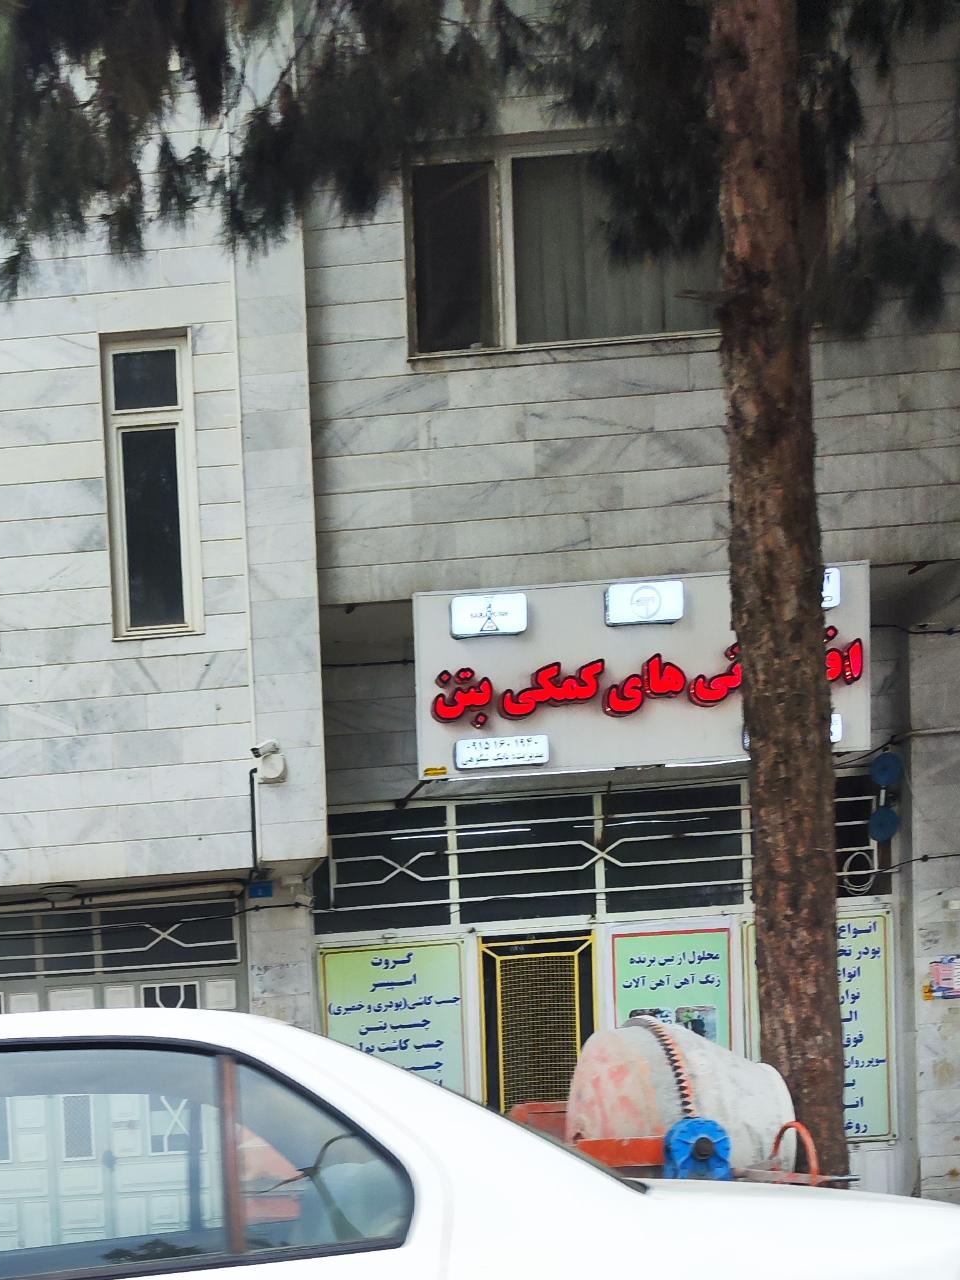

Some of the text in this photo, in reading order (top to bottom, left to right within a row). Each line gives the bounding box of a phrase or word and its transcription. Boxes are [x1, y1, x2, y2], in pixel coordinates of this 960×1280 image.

[432, 668, 493, 729] بتن
[497, 659, 605, 720] کمکی
[371, 952, 414, 969] گروت
